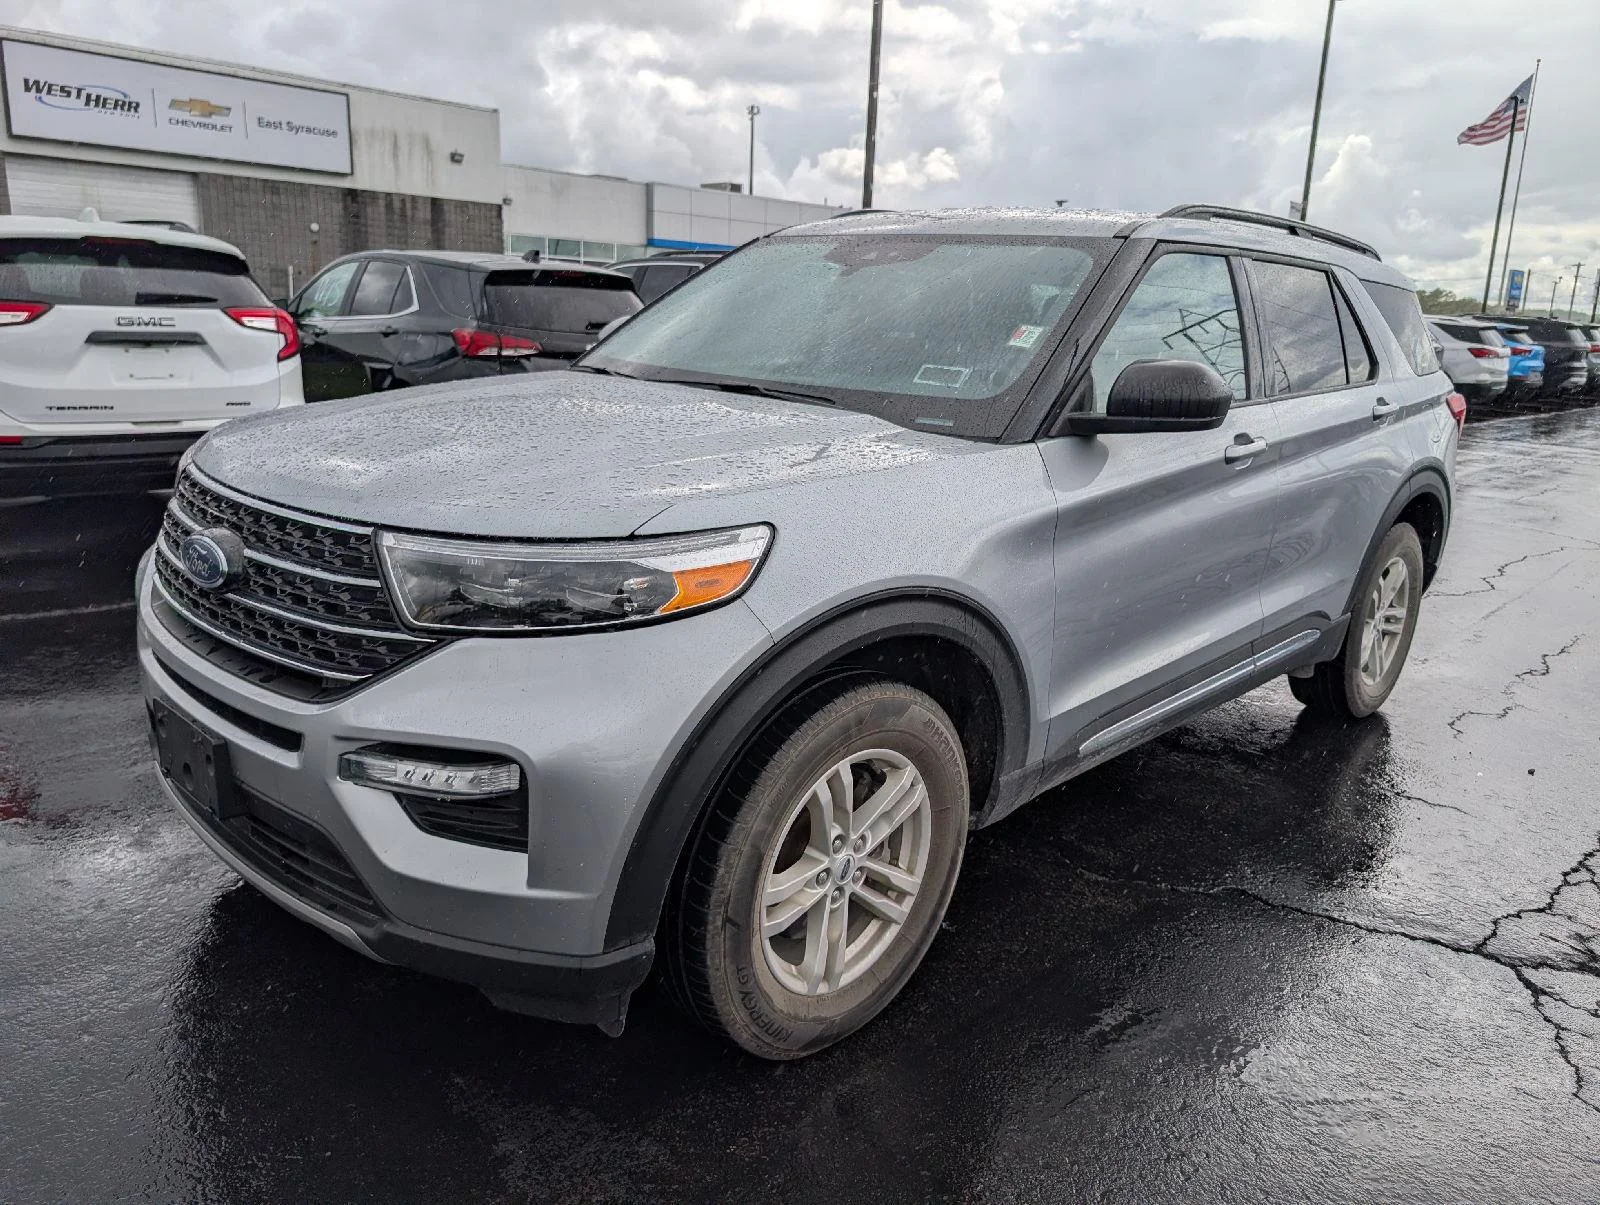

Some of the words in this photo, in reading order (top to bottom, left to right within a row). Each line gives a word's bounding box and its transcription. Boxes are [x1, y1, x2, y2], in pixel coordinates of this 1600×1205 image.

[23, 77, 86, 100] WEST
[84, 92, 140, 114] HERR
[168, 117, 233, 134] CHEVROLET
[256, 116, 284, 131] East
[286, 120, 339, 139] Syracuse
[116, 315, 176, 327] GMC
[186, 544, 214, 577] Ford
